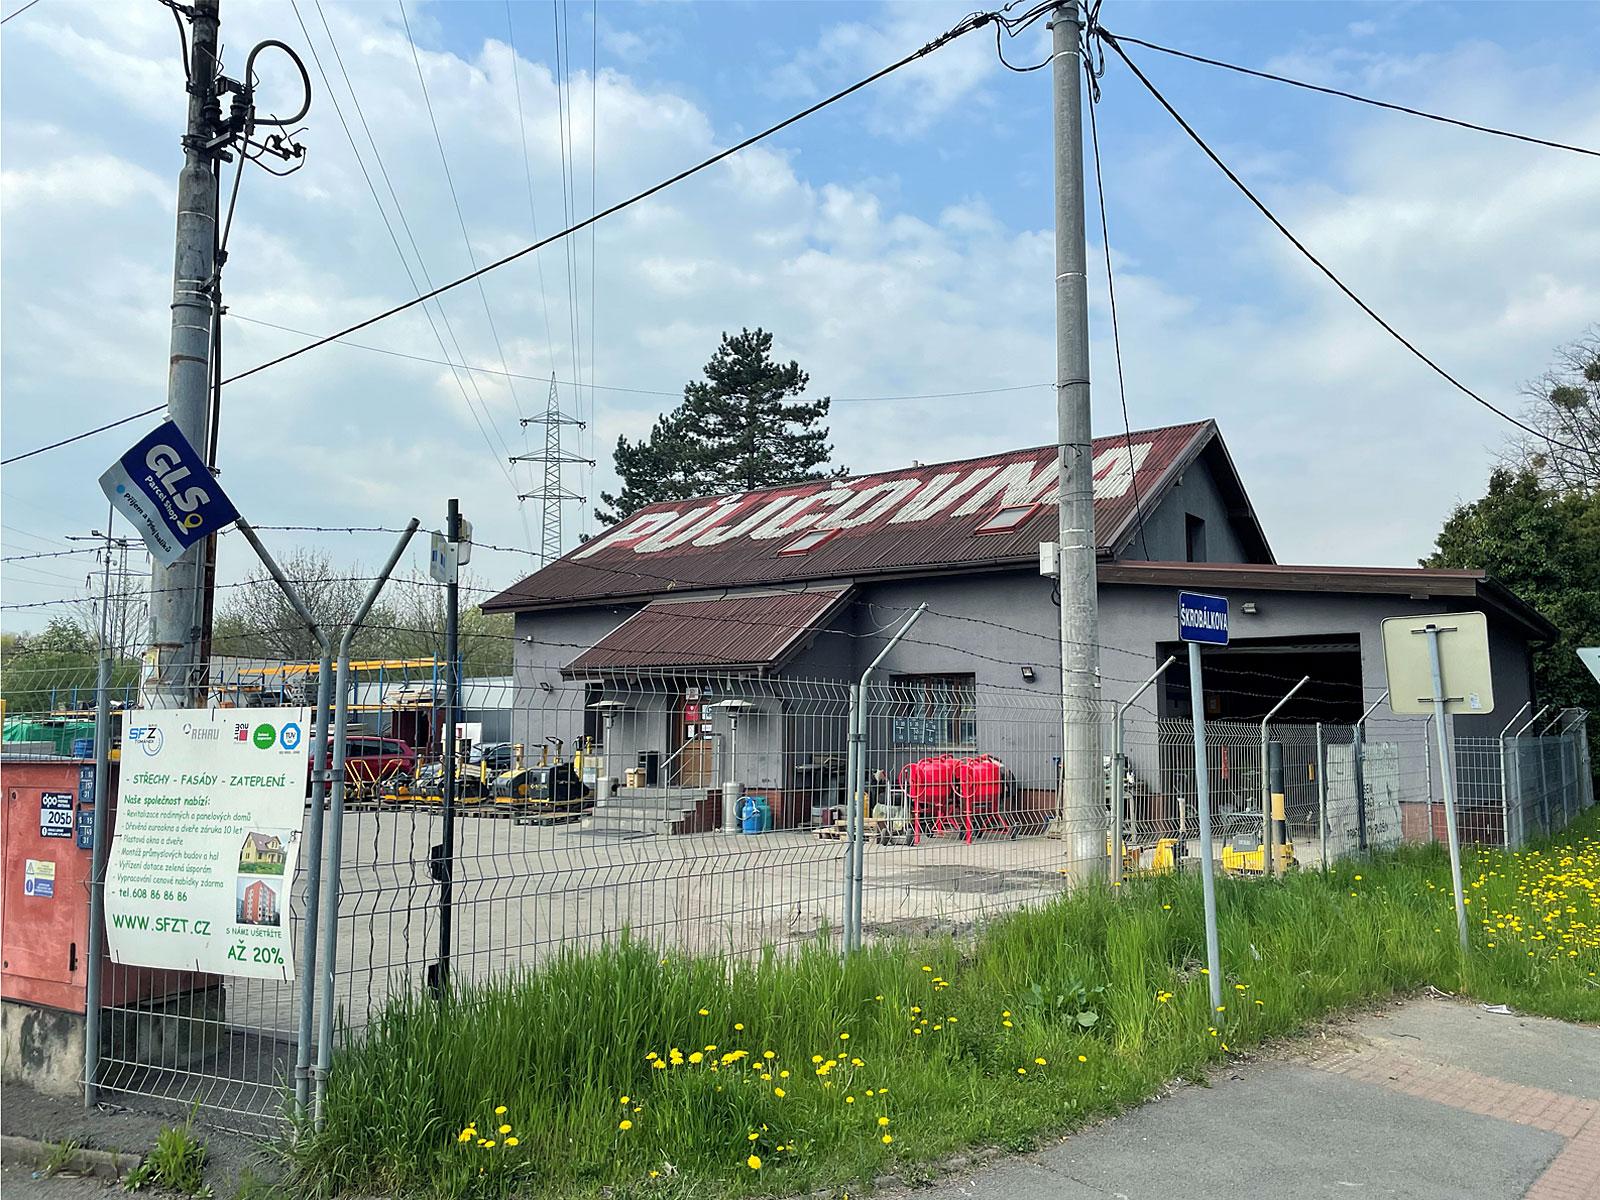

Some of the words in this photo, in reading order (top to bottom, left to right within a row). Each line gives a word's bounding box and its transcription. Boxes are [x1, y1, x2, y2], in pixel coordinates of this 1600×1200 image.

[145, 444, 210, 512] GLS
[144, 475, 167, 503] Parcel
[164, 497, 179, 521] Shop
[1180, 603, 1228, 630] ŠKROBÁLKOVA
[129, 727, 157, 740] SFZ
[191, 728, 220, 740] REHAU
[133, 771, 170, 785] STŘECHY
[181, 771, 218, 786] FASÁDY
[230, 773, 286, 787] ZATEPLENÍ
[124, 794, 141, 805] Naše
[144, 795, 181, 807] společnost
[184, 795, 211, 806] nabízí:
[48, 811, 72, 825] 205b
[127, 809, 159, 818] Revitalizace
[160, 811, 189, 822] rodinných
[196, 811, 233, 822] panelových
[233, 812, 251, 821] domů
[181, 824, 199, 833] dveře
[224, 826, 232, 834] 10
[201, 880, 224, 888] zdarma
[150, 889, 160, 899] 86
[163, 890, 174, 900] 86
[177, 891, 187, 901] 86
[228, 938, 247, 961] AŽ
[253, 947, 284, 964] 20%
